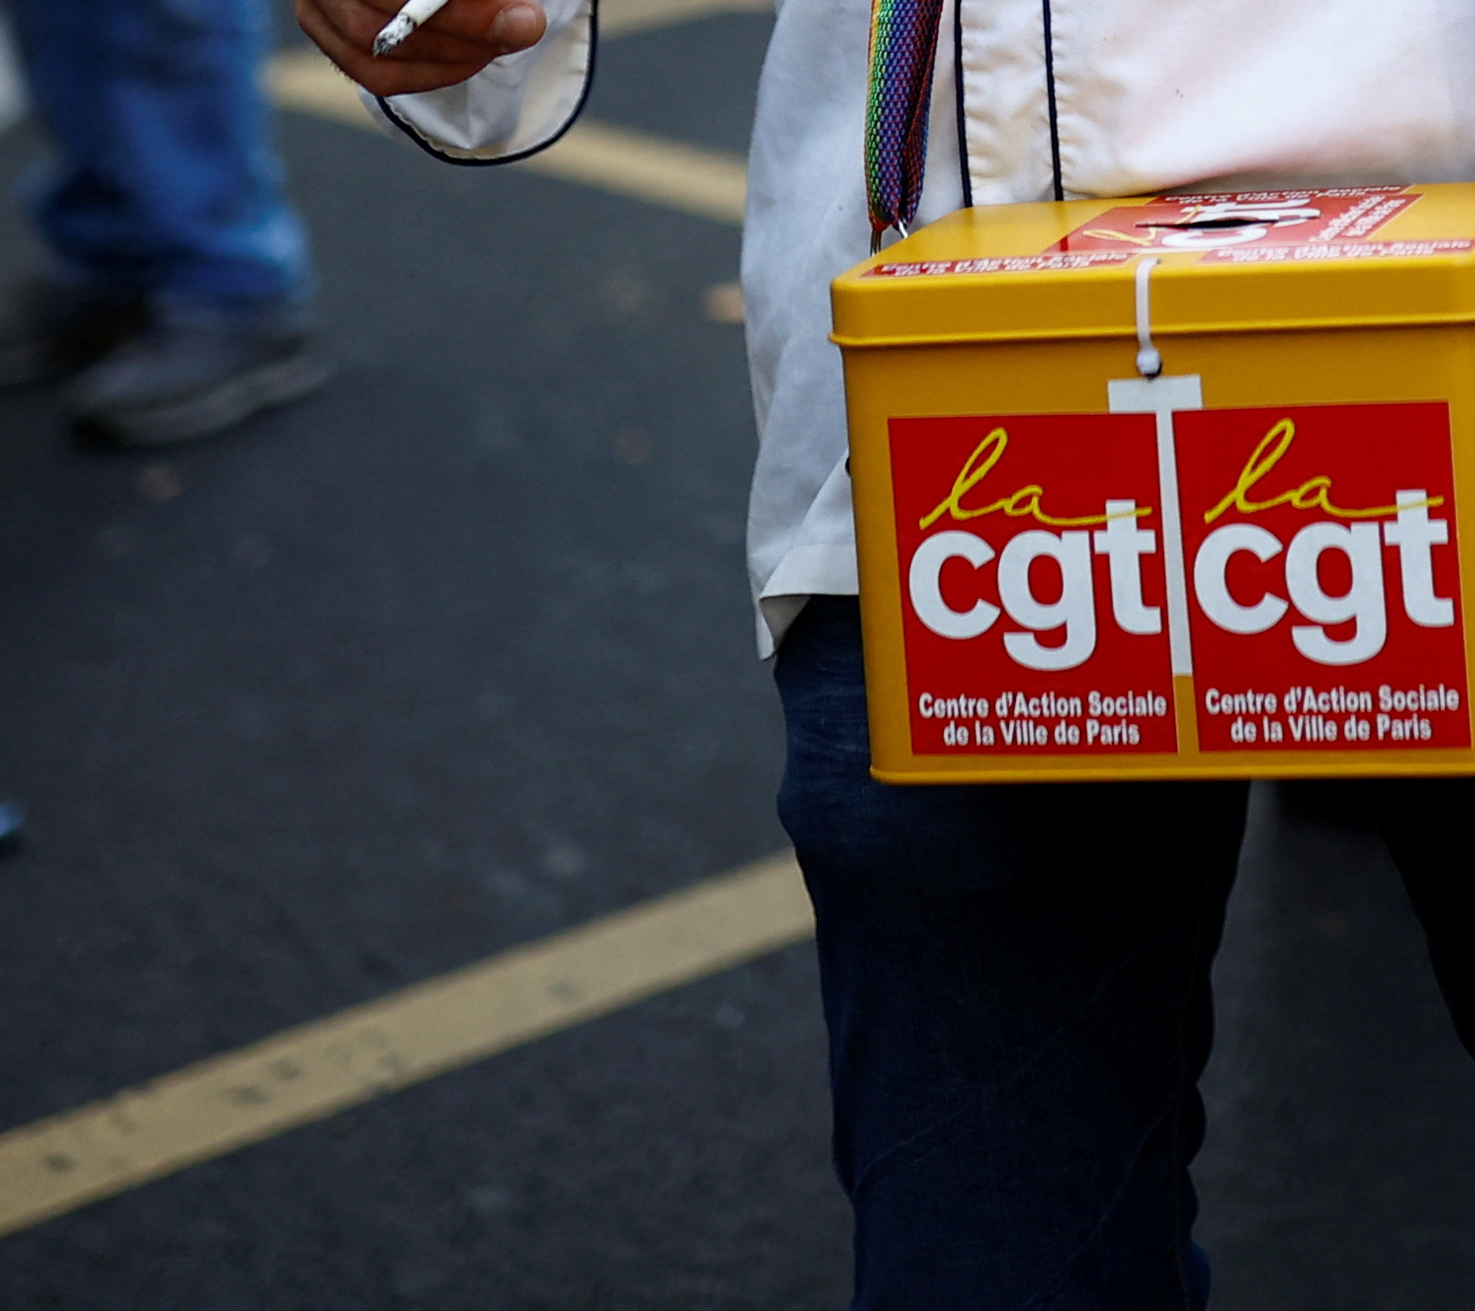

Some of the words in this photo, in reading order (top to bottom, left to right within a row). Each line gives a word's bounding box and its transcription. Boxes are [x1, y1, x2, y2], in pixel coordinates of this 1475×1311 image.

[918, 427, 1152, 530] la
[1204, 417, 1444, 523] la
[908, 498, 1163, 670] cgt
[1193, 488, 1455, 665] cgt
[918, 691, 989, 719] Centre
[995, 690, 1082, 718] d'Action
[1087, 689, 1167, 717] Sociale
[943, 720, 969, 746] de
[975, 720, 995, 746] la
[999, 719, 1048, 746] Ville
[1054, 719, 1080, 745] de
[1085, 718, 1140, 745] Paris
[1205, 687, 1277, 715] Centre
[1283, 685, 1372, 714] d'Action
[1377, 683, 1459, 712] Sociale
[1230, 716, 1256, 743] de
[1263, 715, 1283, 742] la
[1288, 714, 1337, 741] Ville
[1344, 714, 1370, 741] de
[1376, 713, 1432, 741] Paris
